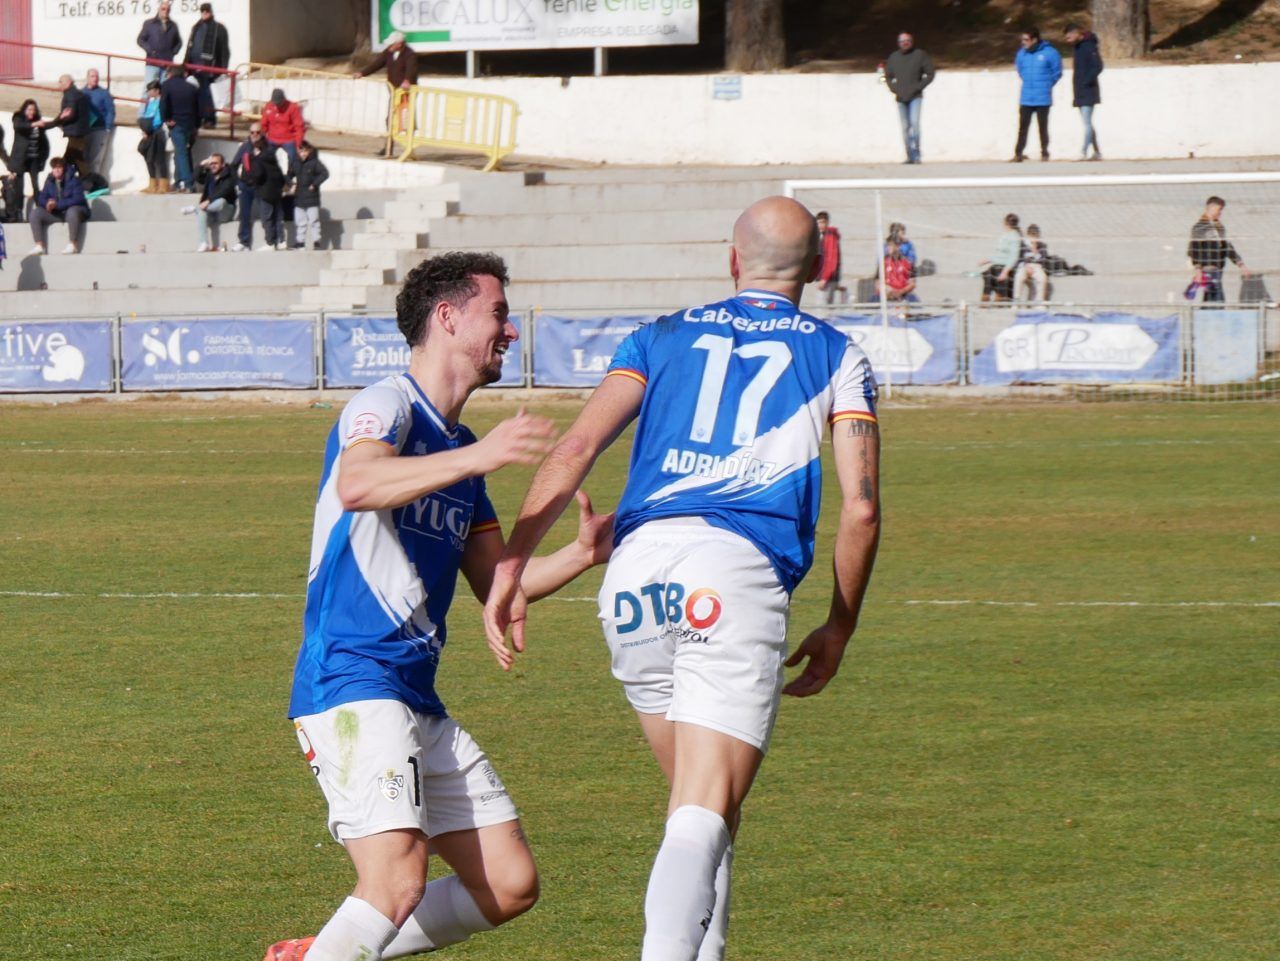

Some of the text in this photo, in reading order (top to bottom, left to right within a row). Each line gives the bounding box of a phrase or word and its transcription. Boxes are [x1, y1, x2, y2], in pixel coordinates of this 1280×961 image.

[59, 3, 91, 17] Telf.
[97, 1, 125, 16] 686
[132, 1, 151, 14] 76
[683, 305, 816, 335] Cabezuelo
[204, 336, 250, 345] FARMACIA
[1002, 337, 1030, 359] GR
[689, 333, 793, 448] 17
[614, 581, 723, 634] DTBO
